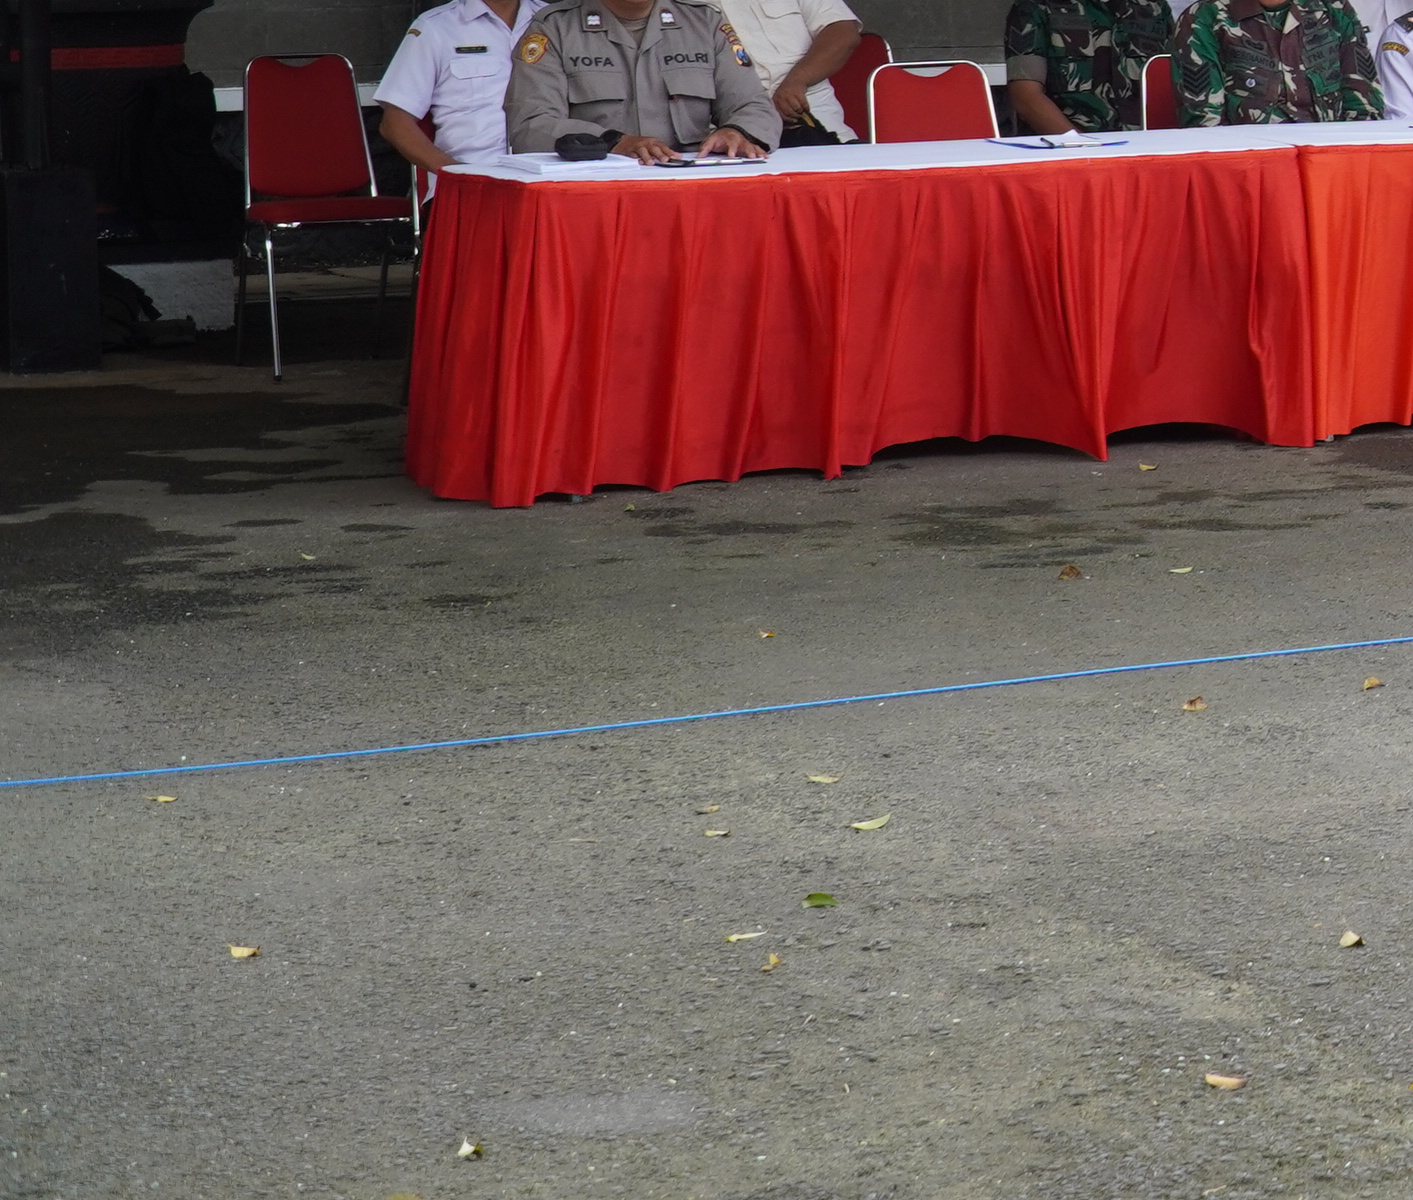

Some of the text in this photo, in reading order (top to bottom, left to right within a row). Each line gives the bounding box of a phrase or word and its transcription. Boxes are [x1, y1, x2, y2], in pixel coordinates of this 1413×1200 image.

[569, 56, 615, 68] YOFA
[664, 52, 709, 66] POLRI
[1307, 50, 1325, 64] TNI
